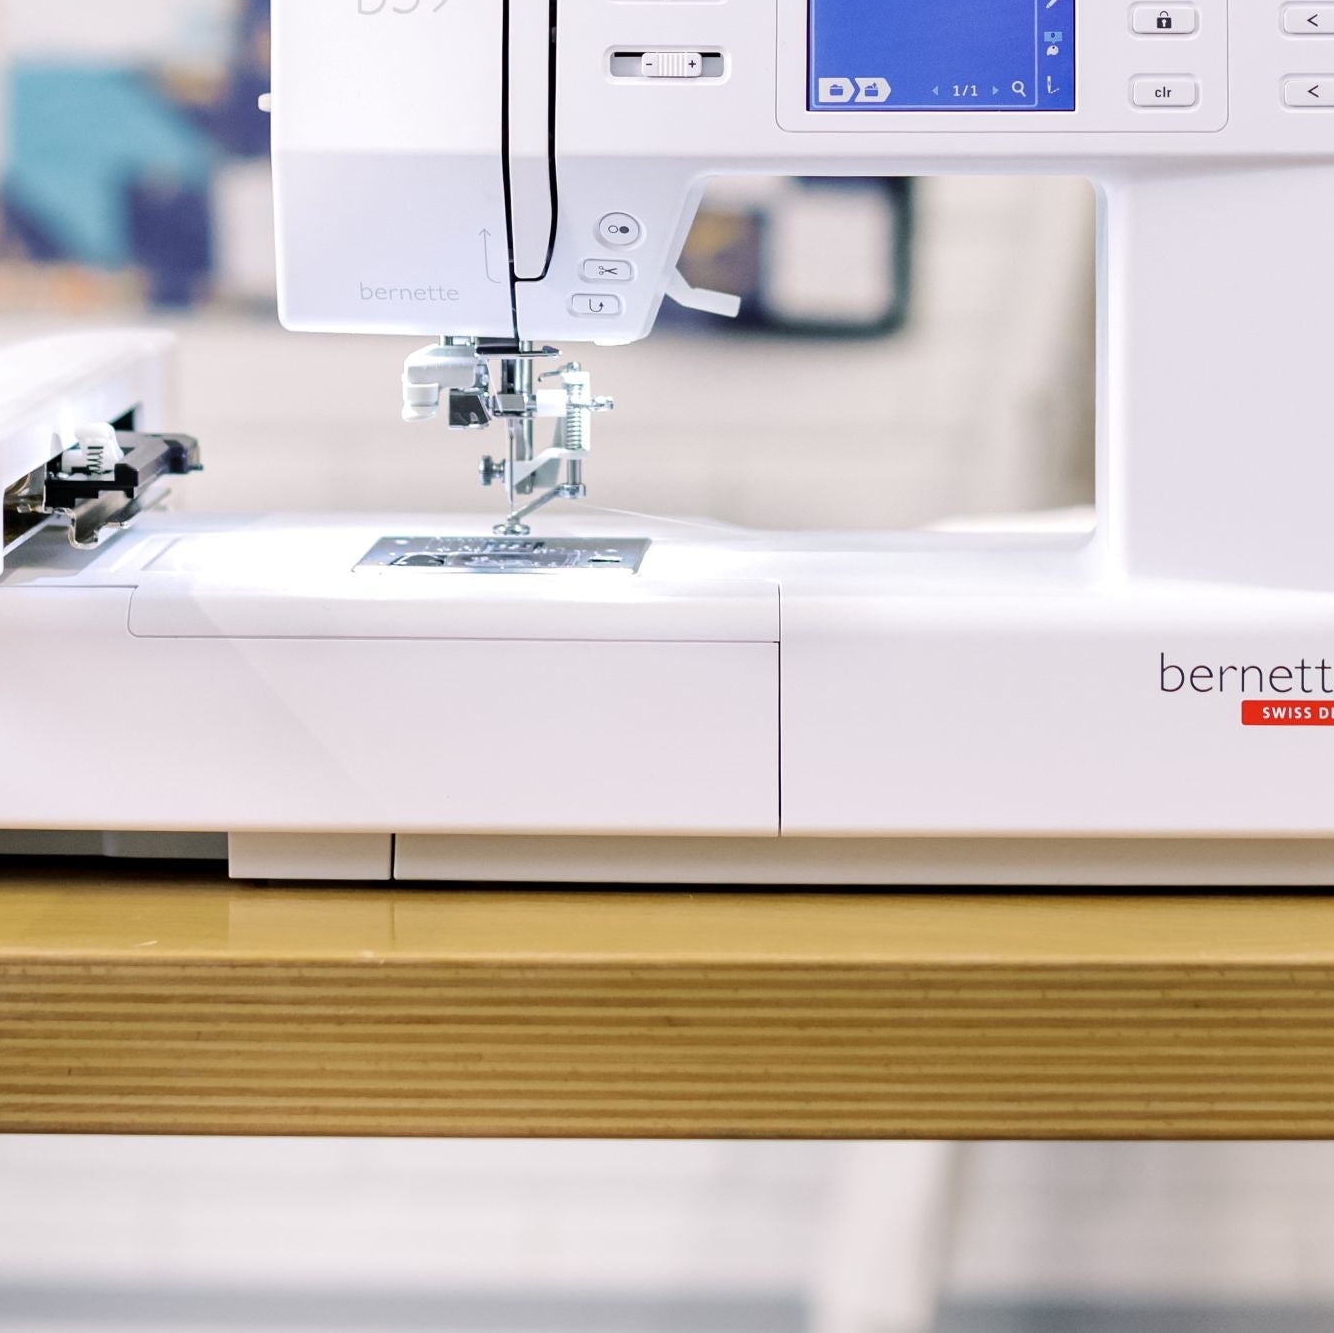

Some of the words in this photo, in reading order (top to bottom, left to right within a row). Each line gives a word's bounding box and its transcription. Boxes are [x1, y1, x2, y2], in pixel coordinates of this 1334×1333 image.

[952, 84, 978, 97] 1/1
[1154, 86, 1172, 99] clr
[359, 282, 460, 303] bernette
[1262, 706, 1312, 719] SWISS
